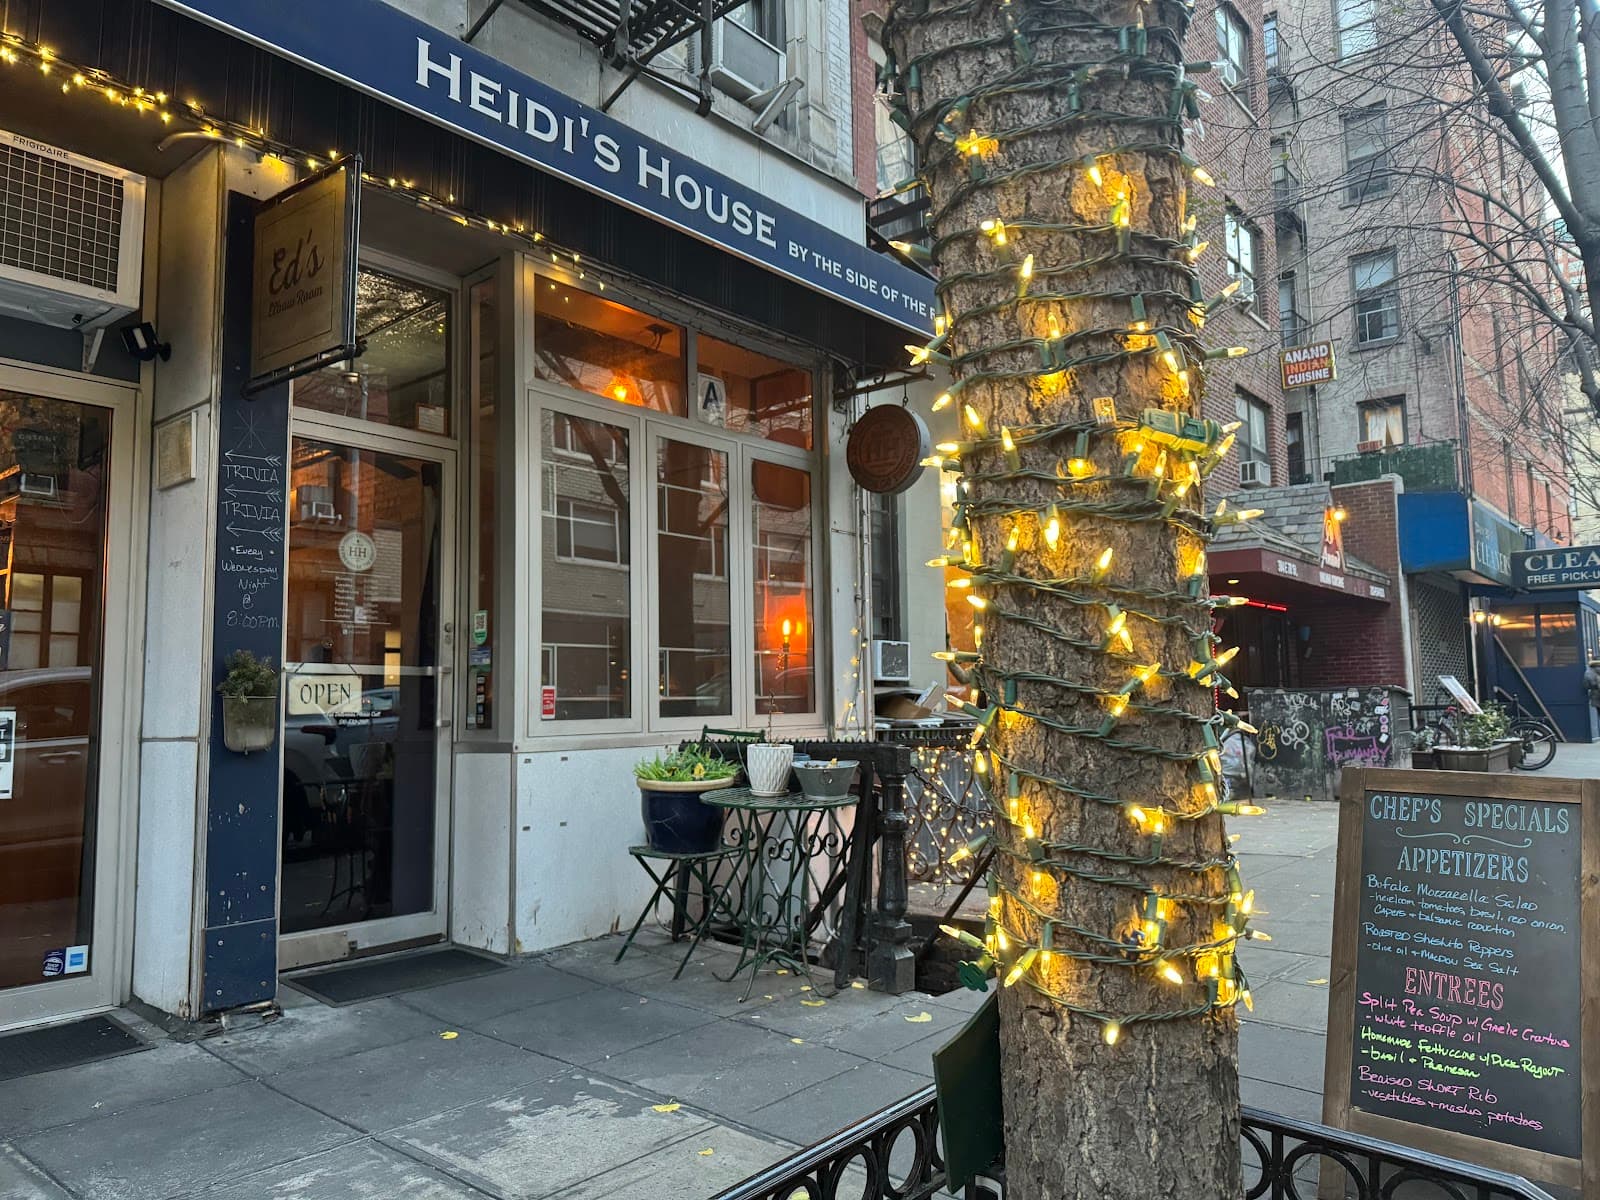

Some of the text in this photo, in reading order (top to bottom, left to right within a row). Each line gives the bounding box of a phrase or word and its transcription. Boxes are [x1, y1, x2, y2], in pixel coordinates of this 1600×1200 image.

[13, 136, 70, 160] FRIGIDAIRE
[416, 36, 621, 173] HEIDI'S
[637, 145, 777, 249] HOUSE
[788, 240, 809, 263] BY
[812, 252, 842, 278] THE
[846, 268, 878, 295] SIDE
[881, 285, 899, 303] OF
[902, 293, 927, 317] THE
[269, 228, 325, 295] Ed's
[1285, 344, 1329, 363] ANAND
[1286, 357, 1329, 375] INDIAN
[1287, 367, 1330, 385] CUISINE
[702, 381, 720, 409] A
[221, 464, 279, 484] TRIVIA
[221, 500, 280, 522] TRIVIA
[238, 577, 270, 594] Night
[1527, 573, 1556, 584] FREE
[300, 682, 351, 706] OPEN
[1369, 794, 1569, 834] CHEF'S SPECIALS
[1396, 846, 1529, 883] APPETIZERS
[1396, 946, 1408, 955] oil
[1463, 957, 1484, 971] Sea
[1488, 962, 1520, 976] Salt
[1468, 939, 1515, 959] Peppers
[1404, 967, 1505, 1011] ENTREES
[1358, 992, 1397, 1012] Split
[1402, 999, 1424, 1016] Pea
[1429, 1006, 1463, 1028] Soup
[1375, 1013, 1407, 1028] white
[1463, 1031, 1481, 1044] oil
[1468, 1086, 1498, 1104] Rib
[1487, 1111, 1544, 1131] potatoes
